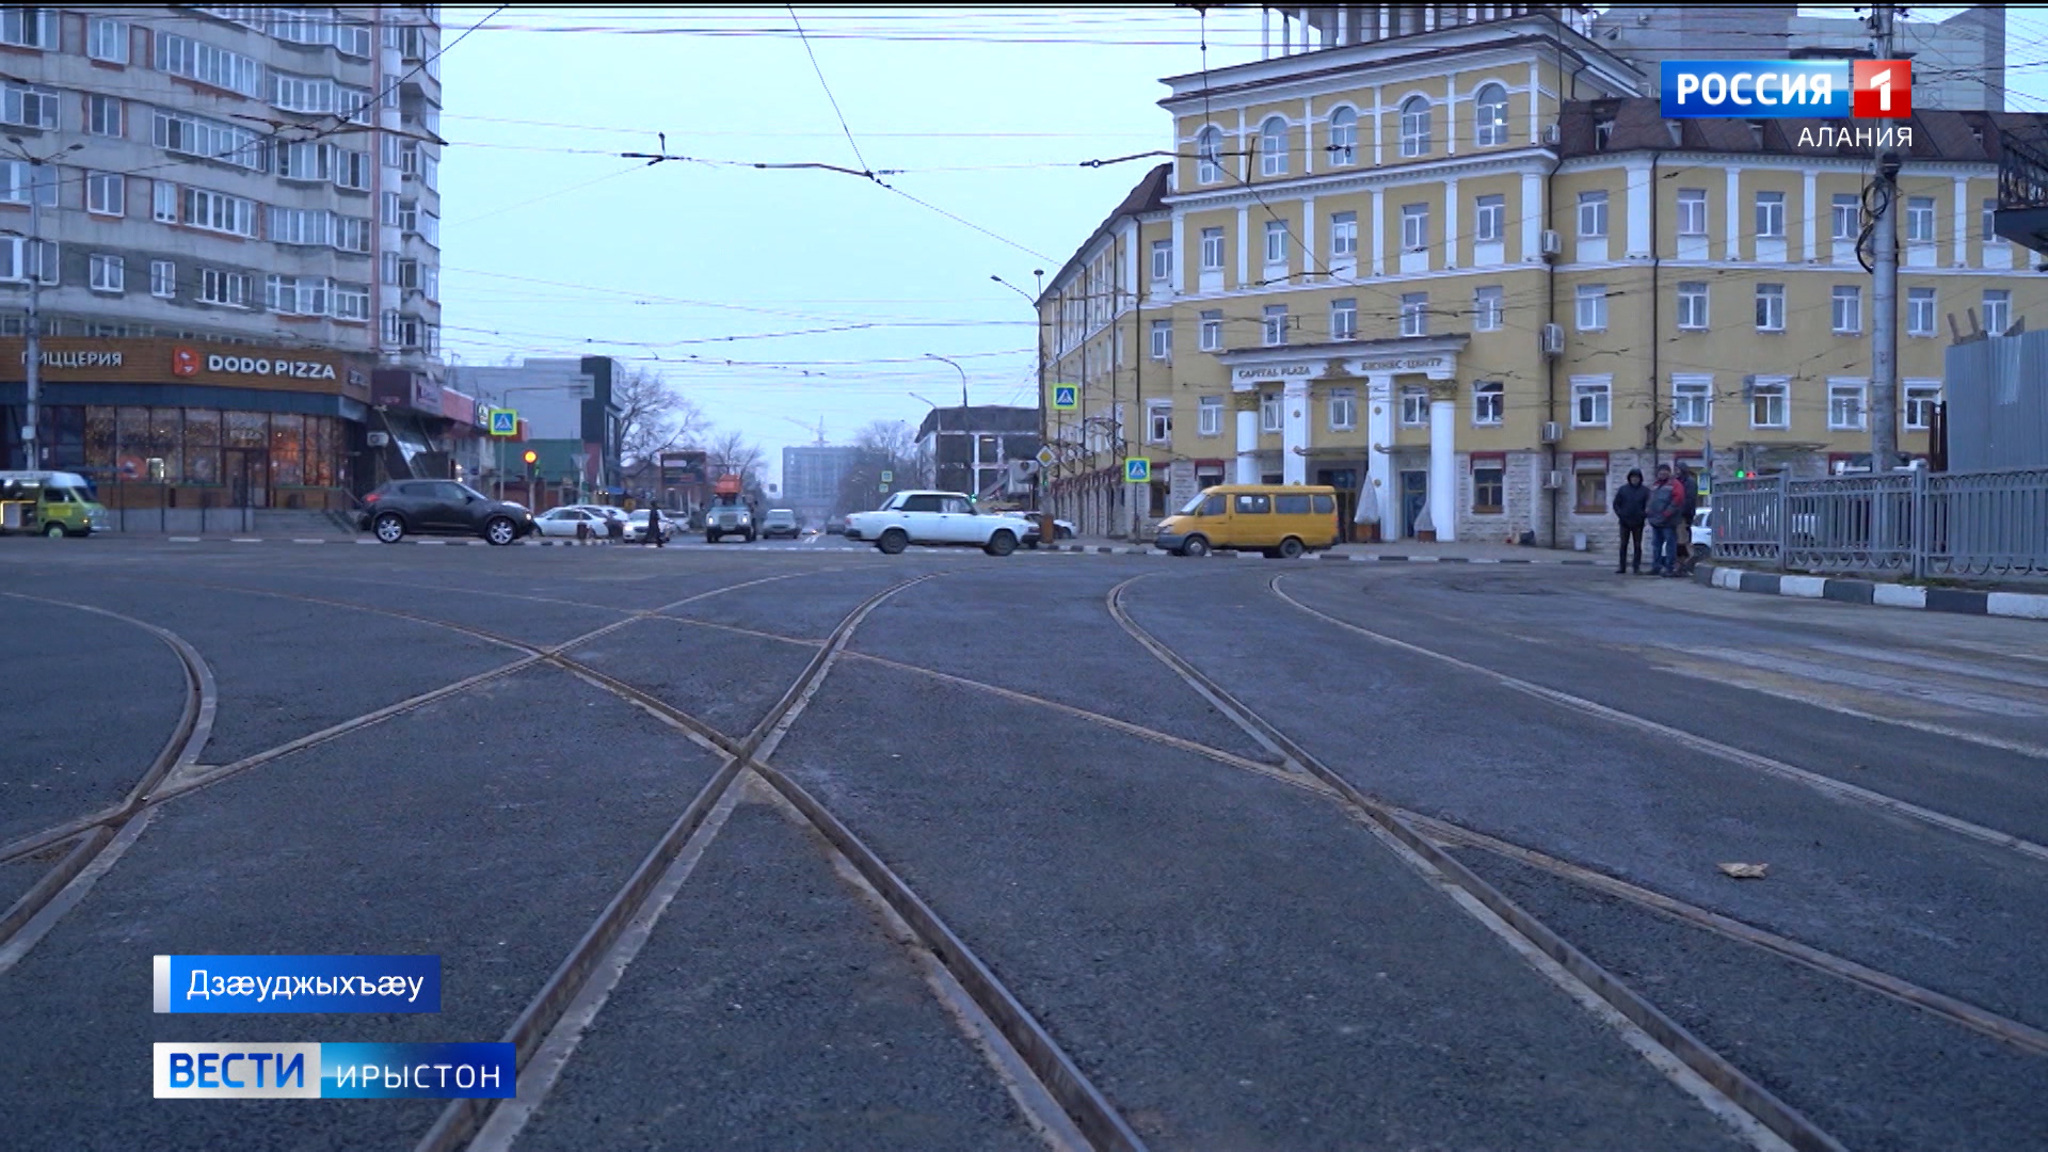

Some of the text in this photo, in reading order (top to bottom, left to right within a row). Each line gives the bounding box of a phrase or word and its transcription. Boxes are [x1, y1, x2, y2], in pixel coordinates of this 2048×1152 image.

[207, 354, 271, 375] DODO
[274, 359, 337, 380] PIZZA
[1238, 365, 1311, 379] CAPITAL PLAZA
